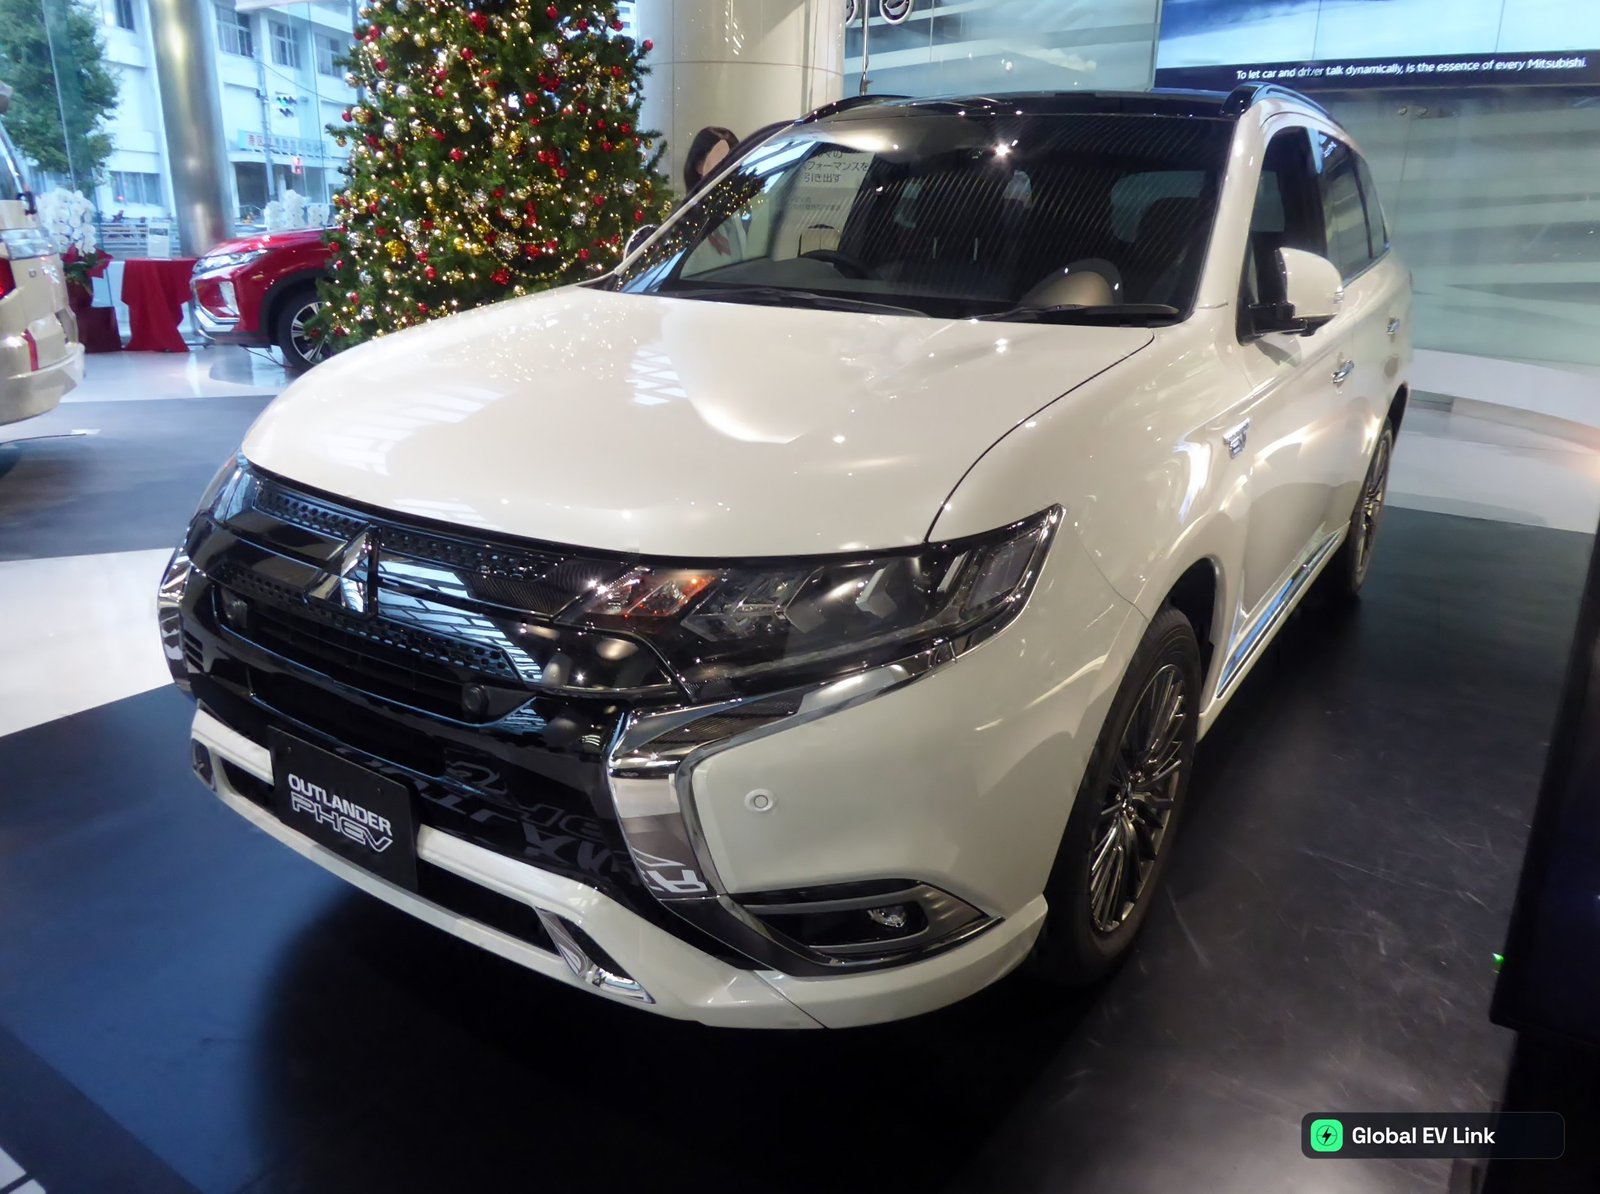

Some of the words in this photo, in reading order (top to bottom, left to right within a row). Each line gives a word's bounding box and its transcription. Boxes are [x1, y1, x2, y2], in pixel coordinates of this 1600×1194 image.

[1236, 70, 1247, 80] To
[1249, 69, 1261, 79] let
[1262, 70, 1276, 79] car
[1278, 68, 1296, 78] and
[1326, 65, 1344, 75] talk
[1345, 63, 1403, 77] dynamically,
[1406, 63, 1415, 73] is
[1417, 63, 1435, 72] the
[1436, 62, 1479, 71] essence
[1482, 59, 1495, 70] of
[1495, 61, 1526, 71] every
[1527, 57, 1587, 69] Mitsubishi.
[288, 773, 393, 837] OUTLANDER
[291, 791, 394, 853] PHEV
